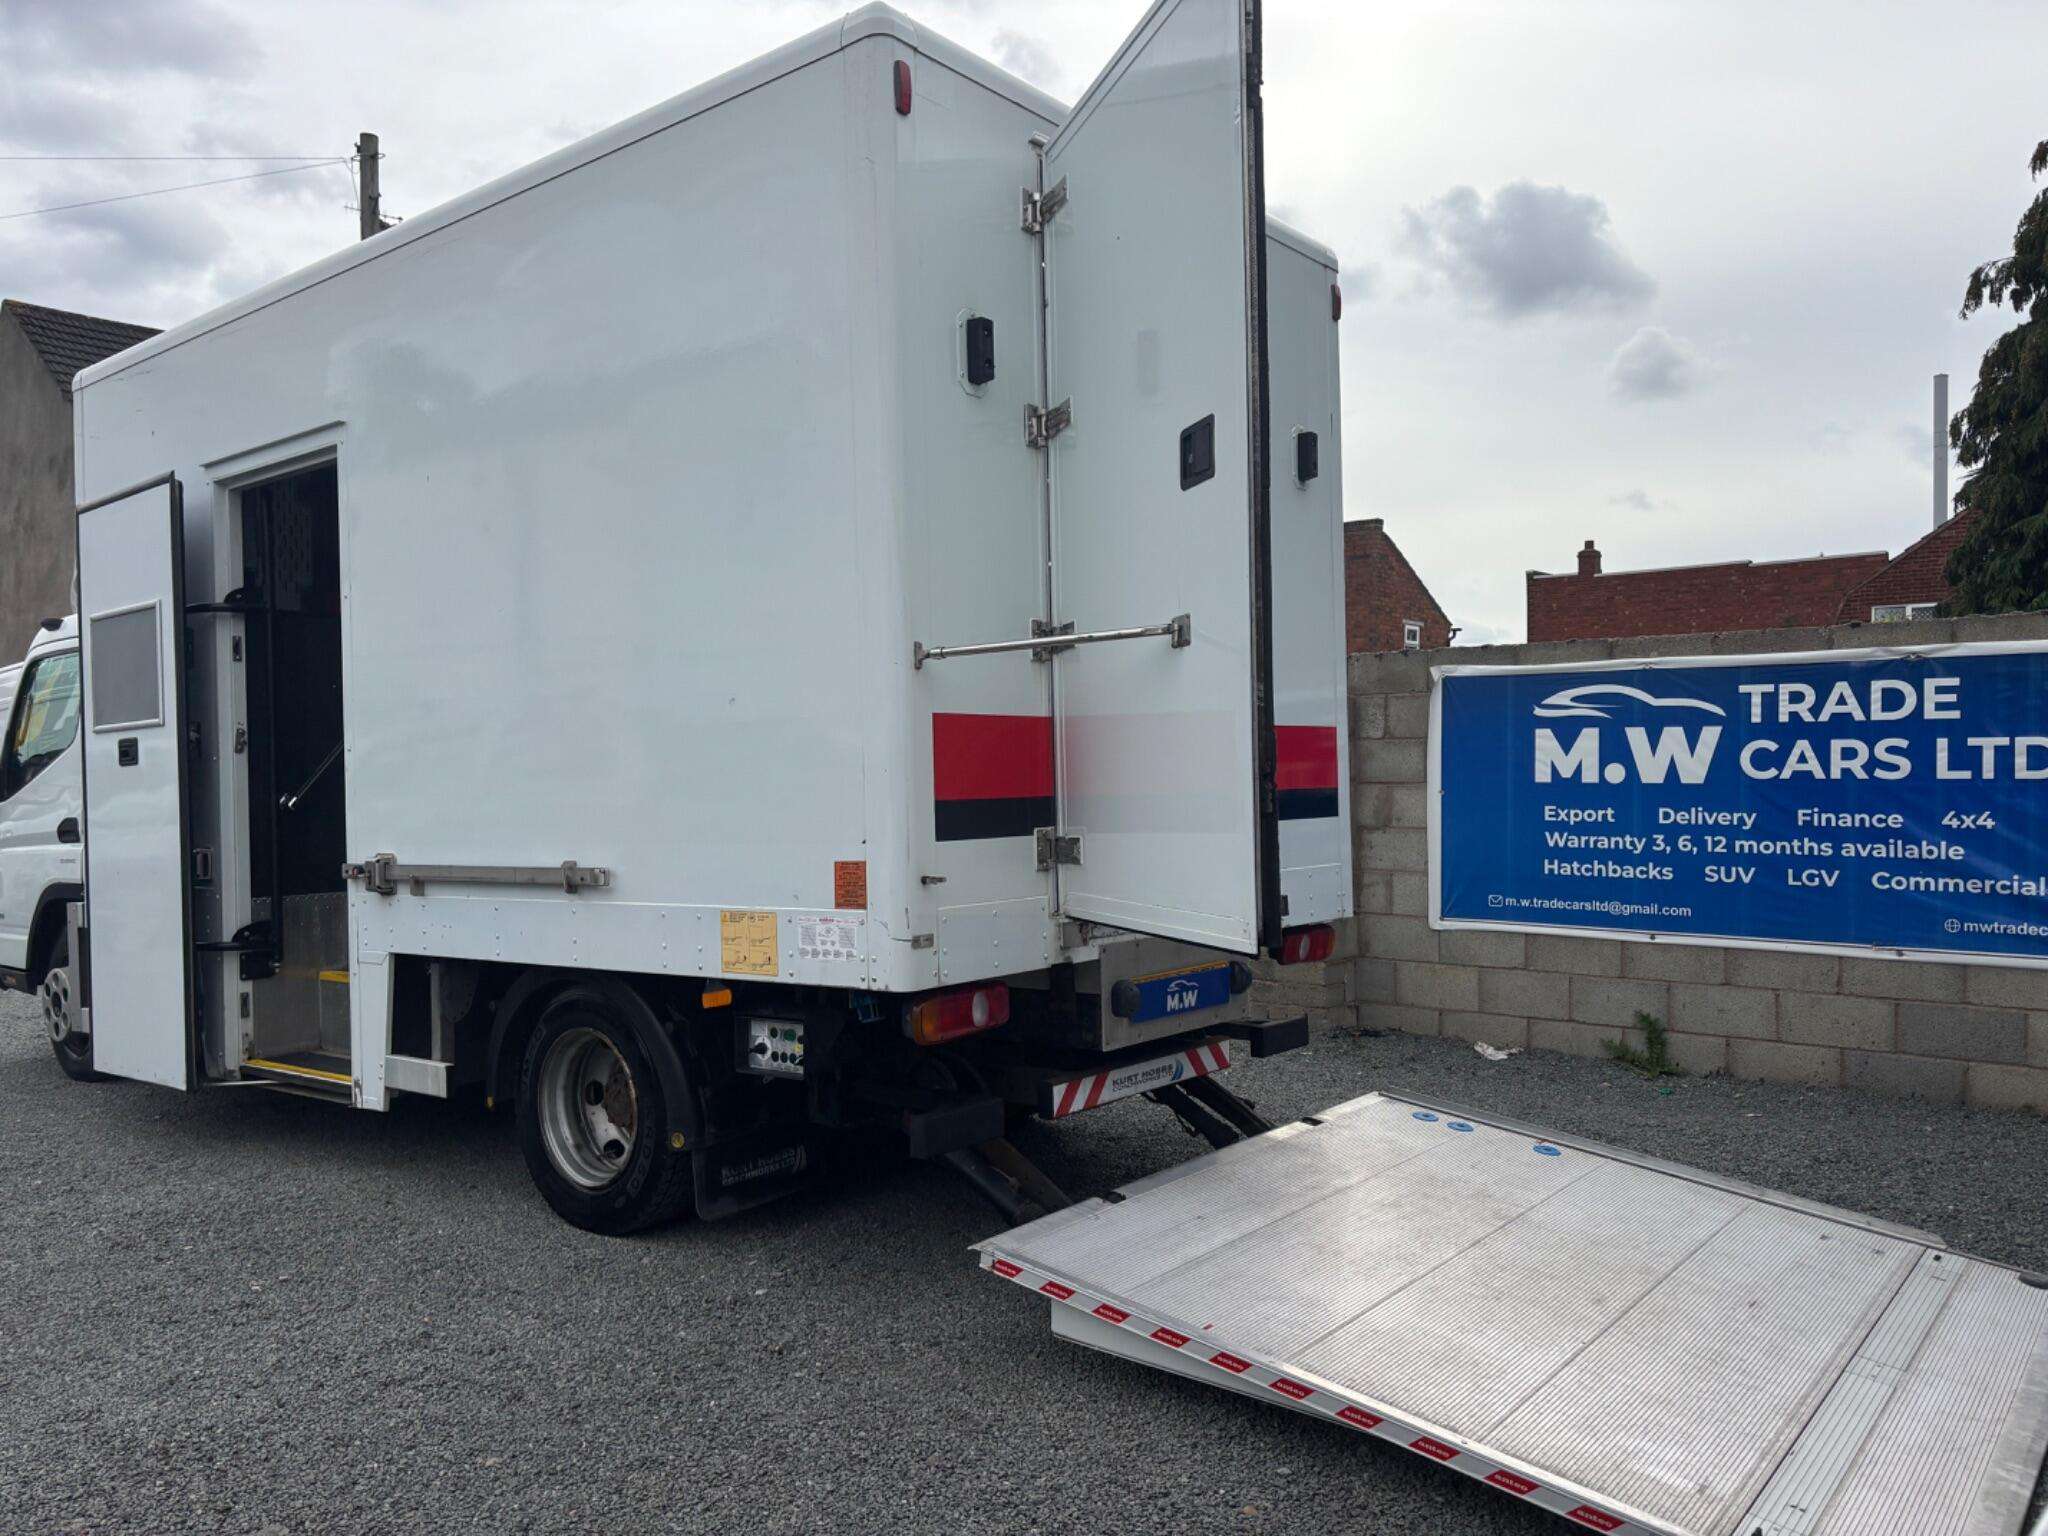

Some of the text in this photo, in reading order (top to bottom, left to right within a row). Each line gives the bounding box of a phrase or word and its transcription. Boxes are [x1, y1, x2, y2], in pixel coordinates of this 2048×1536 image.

[1738, 677, 1961, 723] TRADE
[1534, 726, 1723, 784] M.W
[1739, 736, 2048, 780] CARS LTD
[1544, 805, 1996, 830] Export Delivery Finance 4x4
[1545, 831, 1965, 860] Warranty 3, 6, 12 months available
[1543, 859, 1674, 880] Hatchbacks
[1704, 865, 1756, 883] SUV
[1787, 869, 1840, 887] LGV
[1505, 896, 1692, 917] m.w.tradecarsltd@gmail.com
[1964, 921, 2048, 936] mwtradec
[1166, 989, 1199, 1012] M.W
